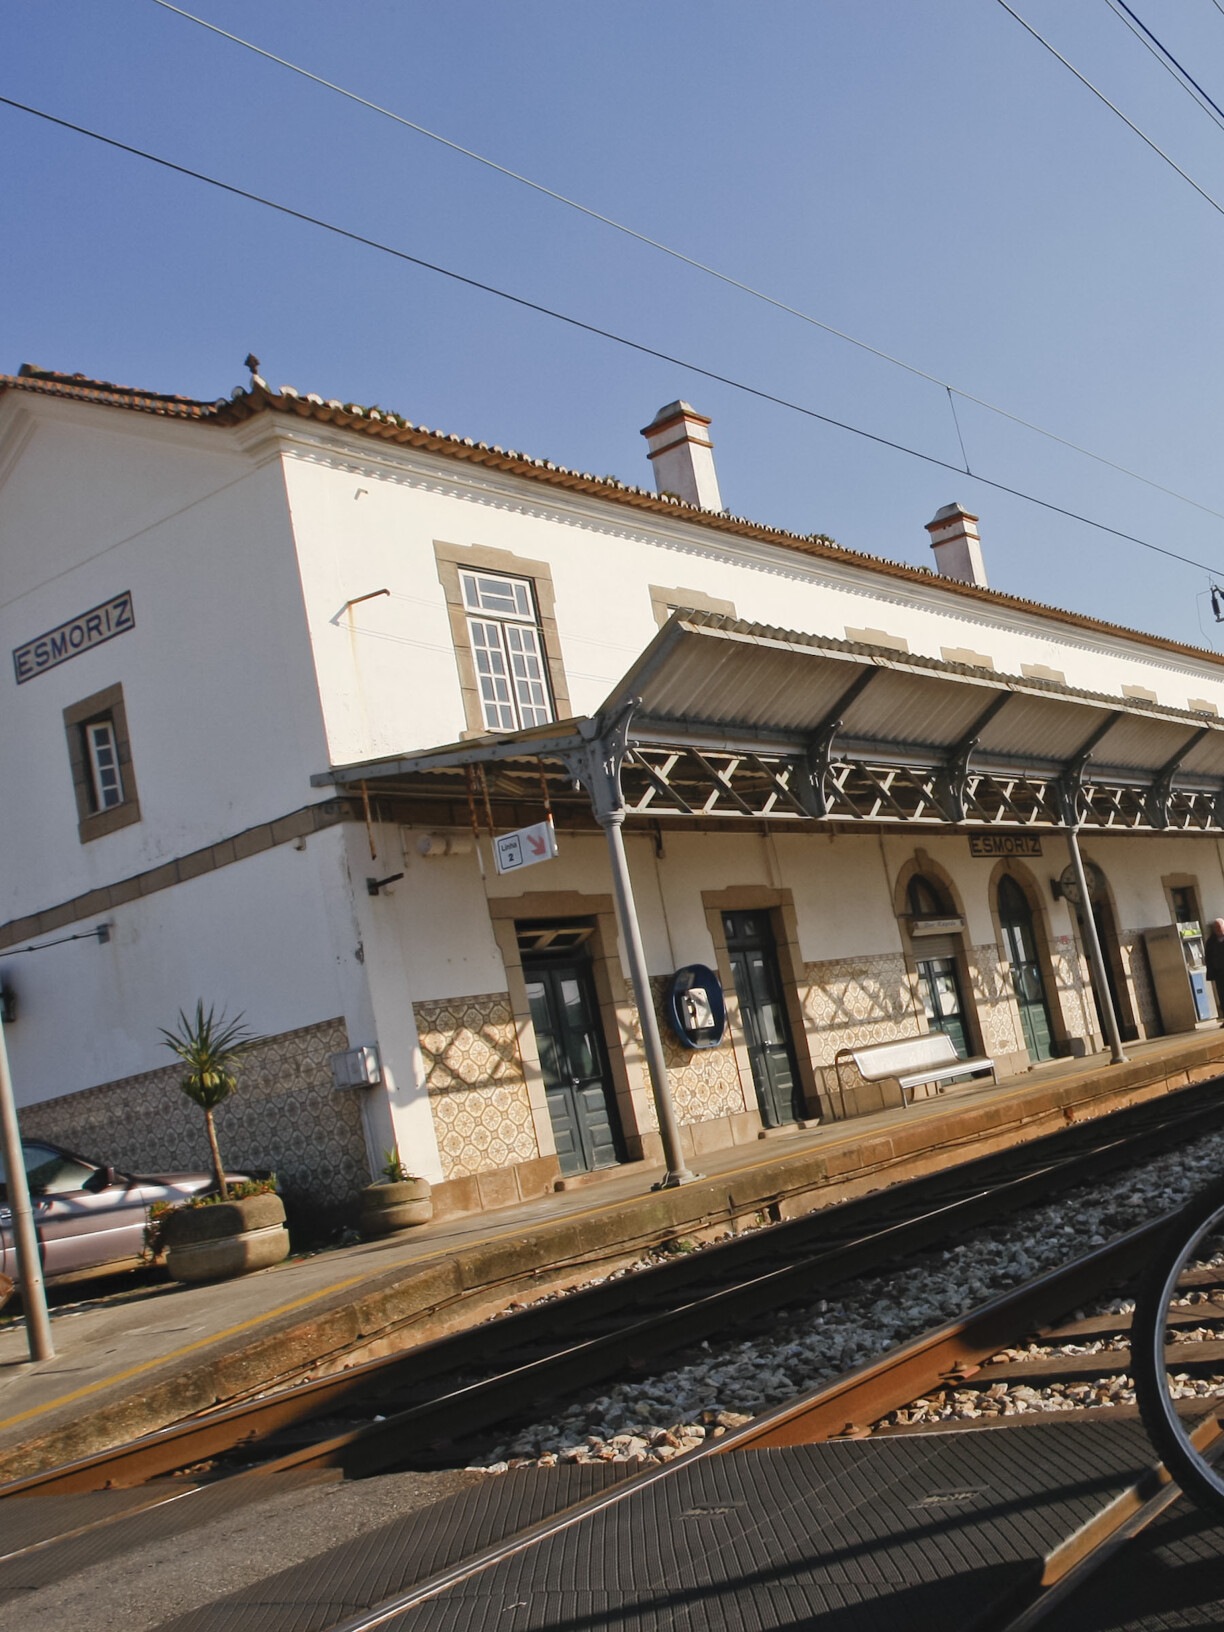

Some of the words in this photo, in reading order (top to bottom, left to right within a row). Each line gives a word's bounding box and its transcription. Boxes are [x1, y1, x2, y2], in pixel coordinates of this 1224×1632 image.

[16, 599, 131, 677] ESMORIZ
[501, 842, 518, 852] Linha
[971, 837, 1040, 853] ESMORIZ
[508, 853, 515, 862] 2
